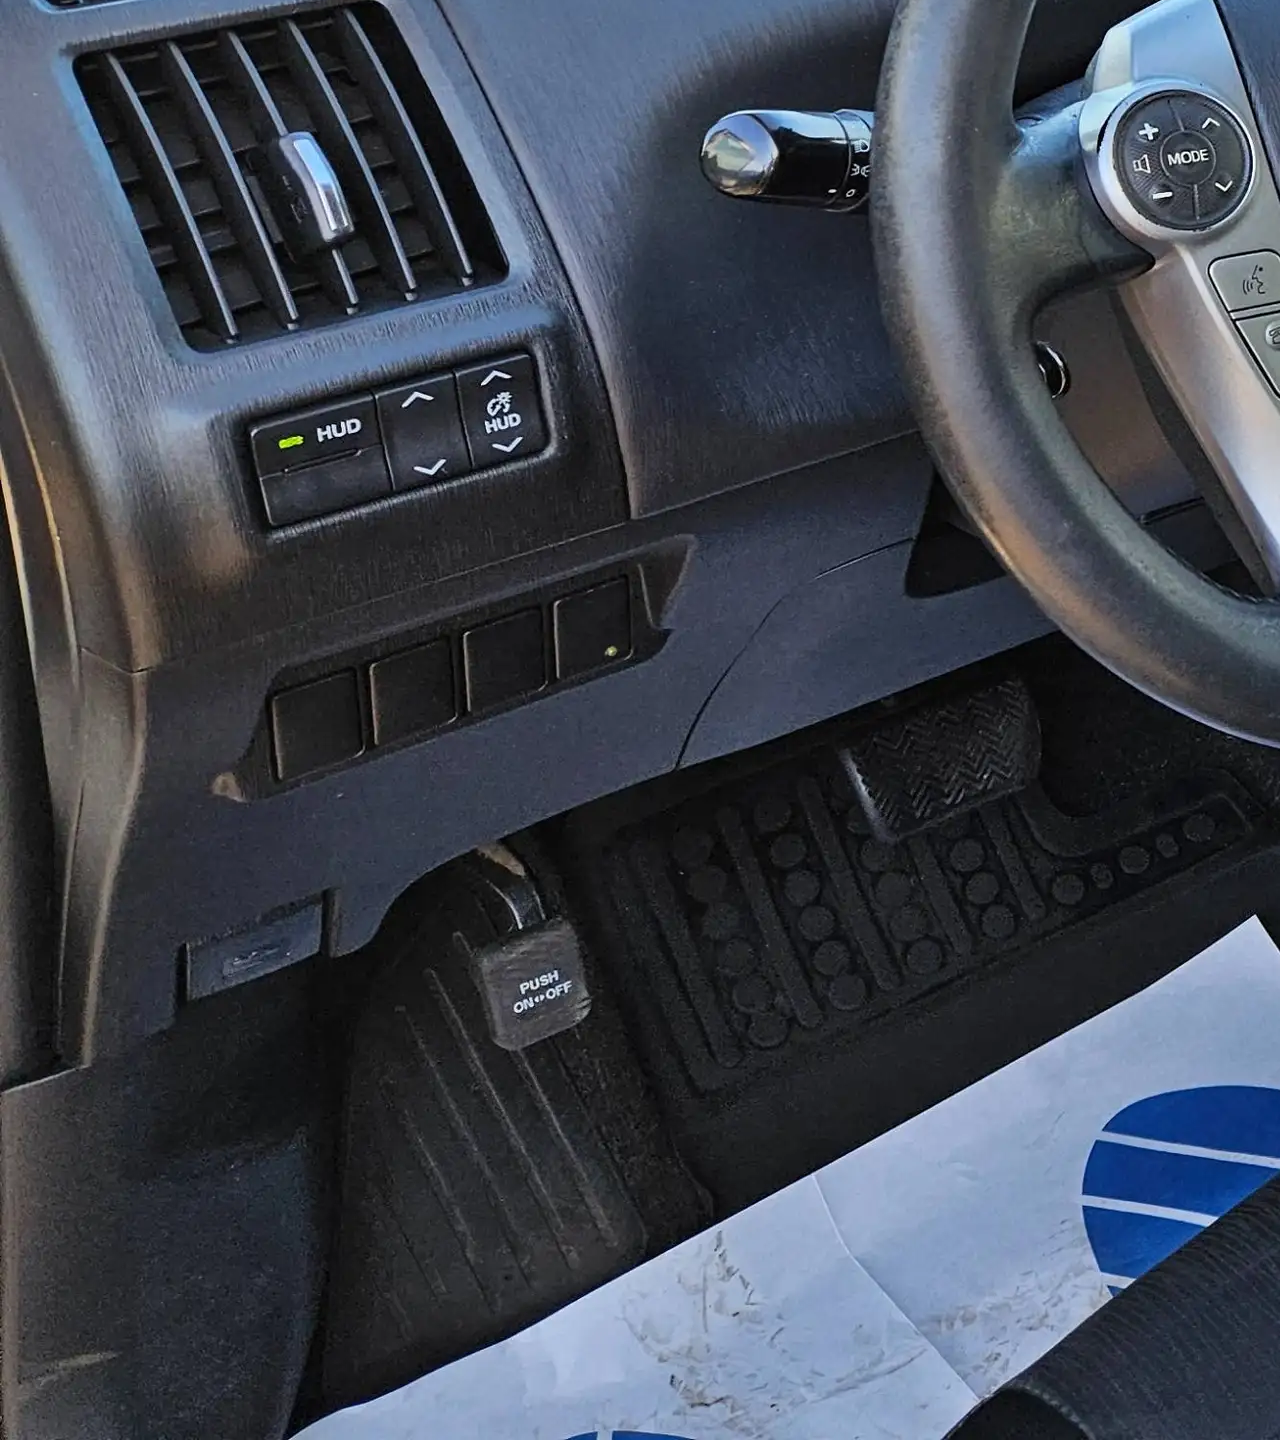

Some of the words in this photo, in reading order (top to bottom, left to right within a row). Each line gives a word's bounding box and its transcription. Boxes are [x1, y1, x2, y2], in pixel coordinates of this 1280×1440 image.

[1167, 148, 1210, 166] MODE
[316, 418, 362, 443] HUD
[484, 412, 522, 435] HUD
[519, 969, 560, 995] PUSH
[513, 996, 535, 1014] ON
[545, 980, 573, 1000] OFF
